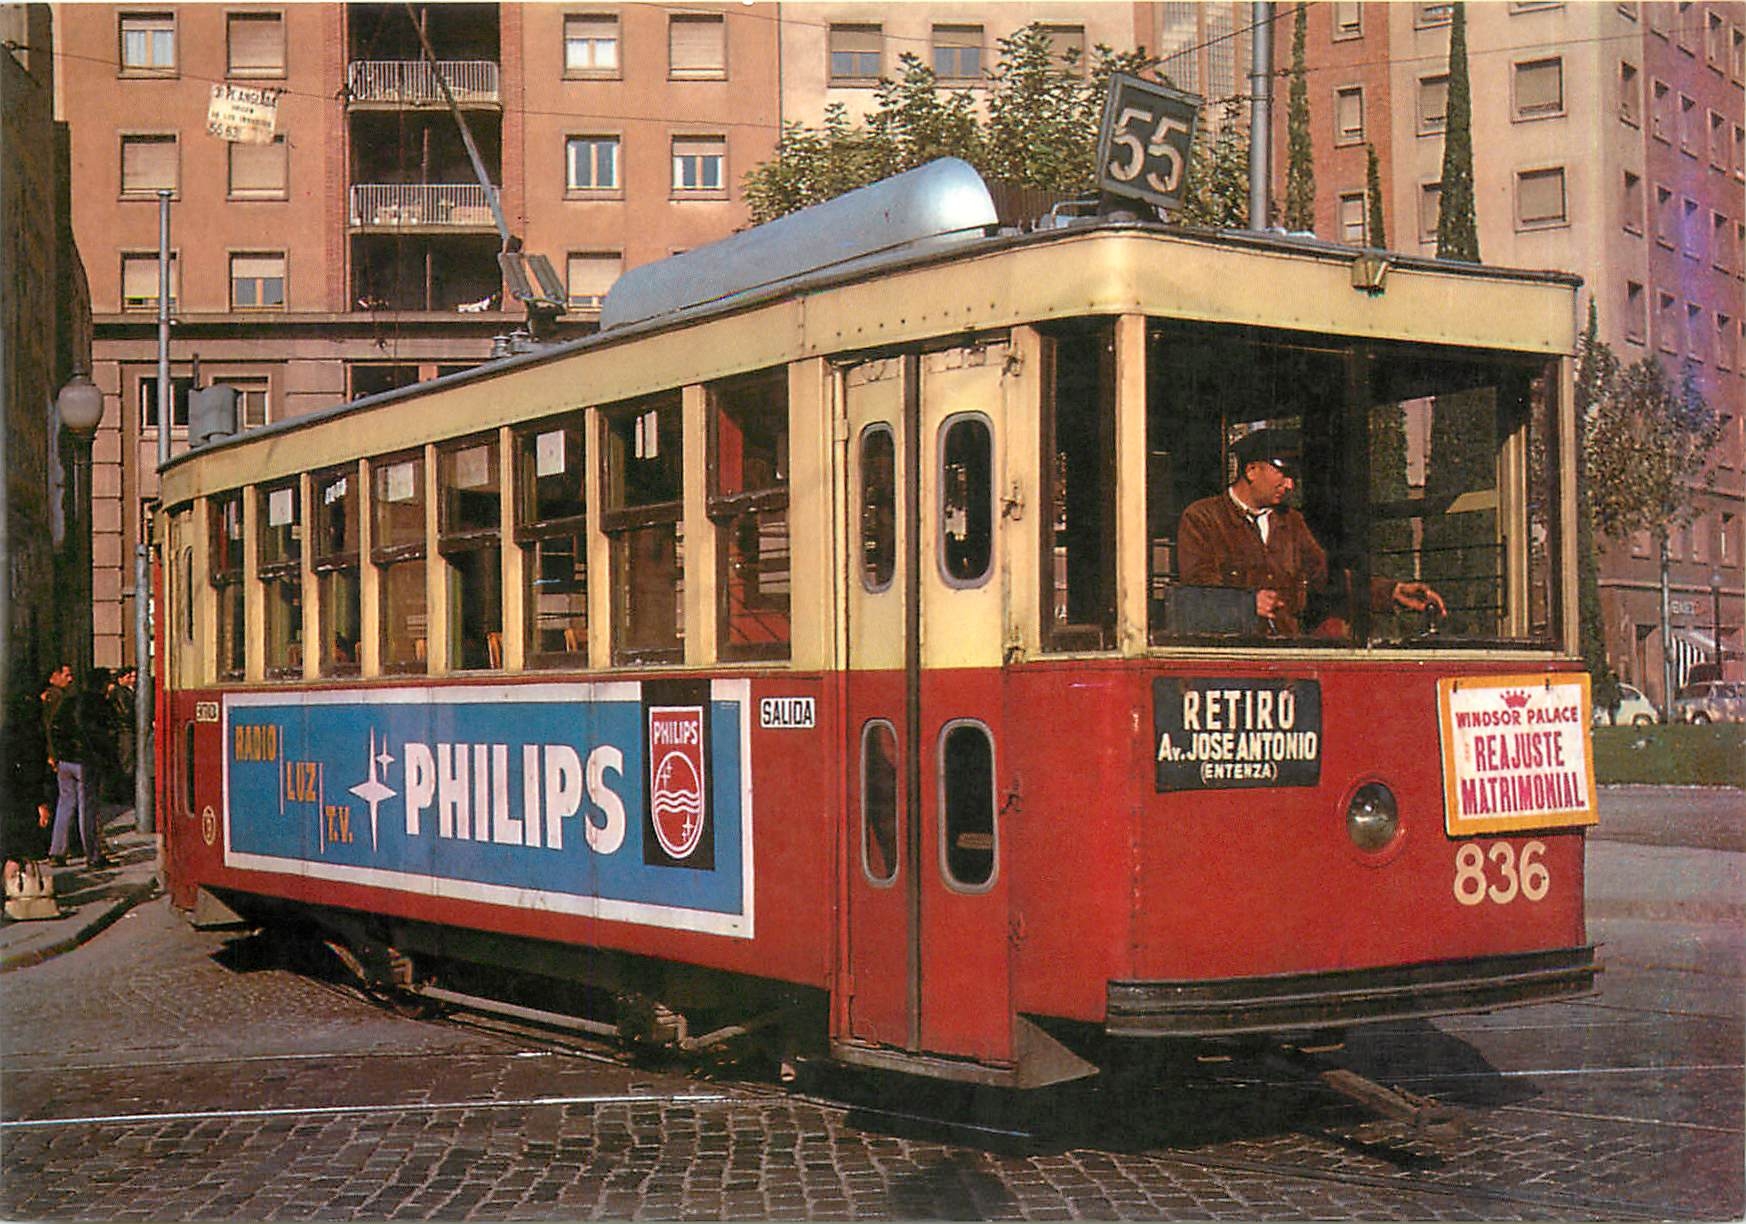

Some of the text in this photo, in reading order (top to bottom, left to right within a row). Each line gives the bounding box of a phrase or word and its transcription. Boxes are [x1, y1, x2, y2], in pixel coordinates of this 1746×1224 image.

[1109, 107, 1187, 192] 55
[762, 700, 814, 726] SALIDA
[1183, 689, 1295, 731] RETIRO
[1455, 705, 1579, 729] WINDSOR PALACE
[235, 724, 278, 762] RADIO
[653, 719, 699, 745] PHILIPS
[1186, 732, 1235, 761] JOSE
[1235, 731, 1318, 761] ANTONIO
[1474, 730, 1566, 772] REAJUSTE
[286, 761, 318, 803] LUZ
[1201, 760, 1279, 784] (ENTENZA)
[404, 742, 628, 856] PHILIPS
[1460, 771, 1586, 816] MATRIMONIAL
[325, 805, 353, 844] T.V.
[1453, 840, 1550, 906] 836
